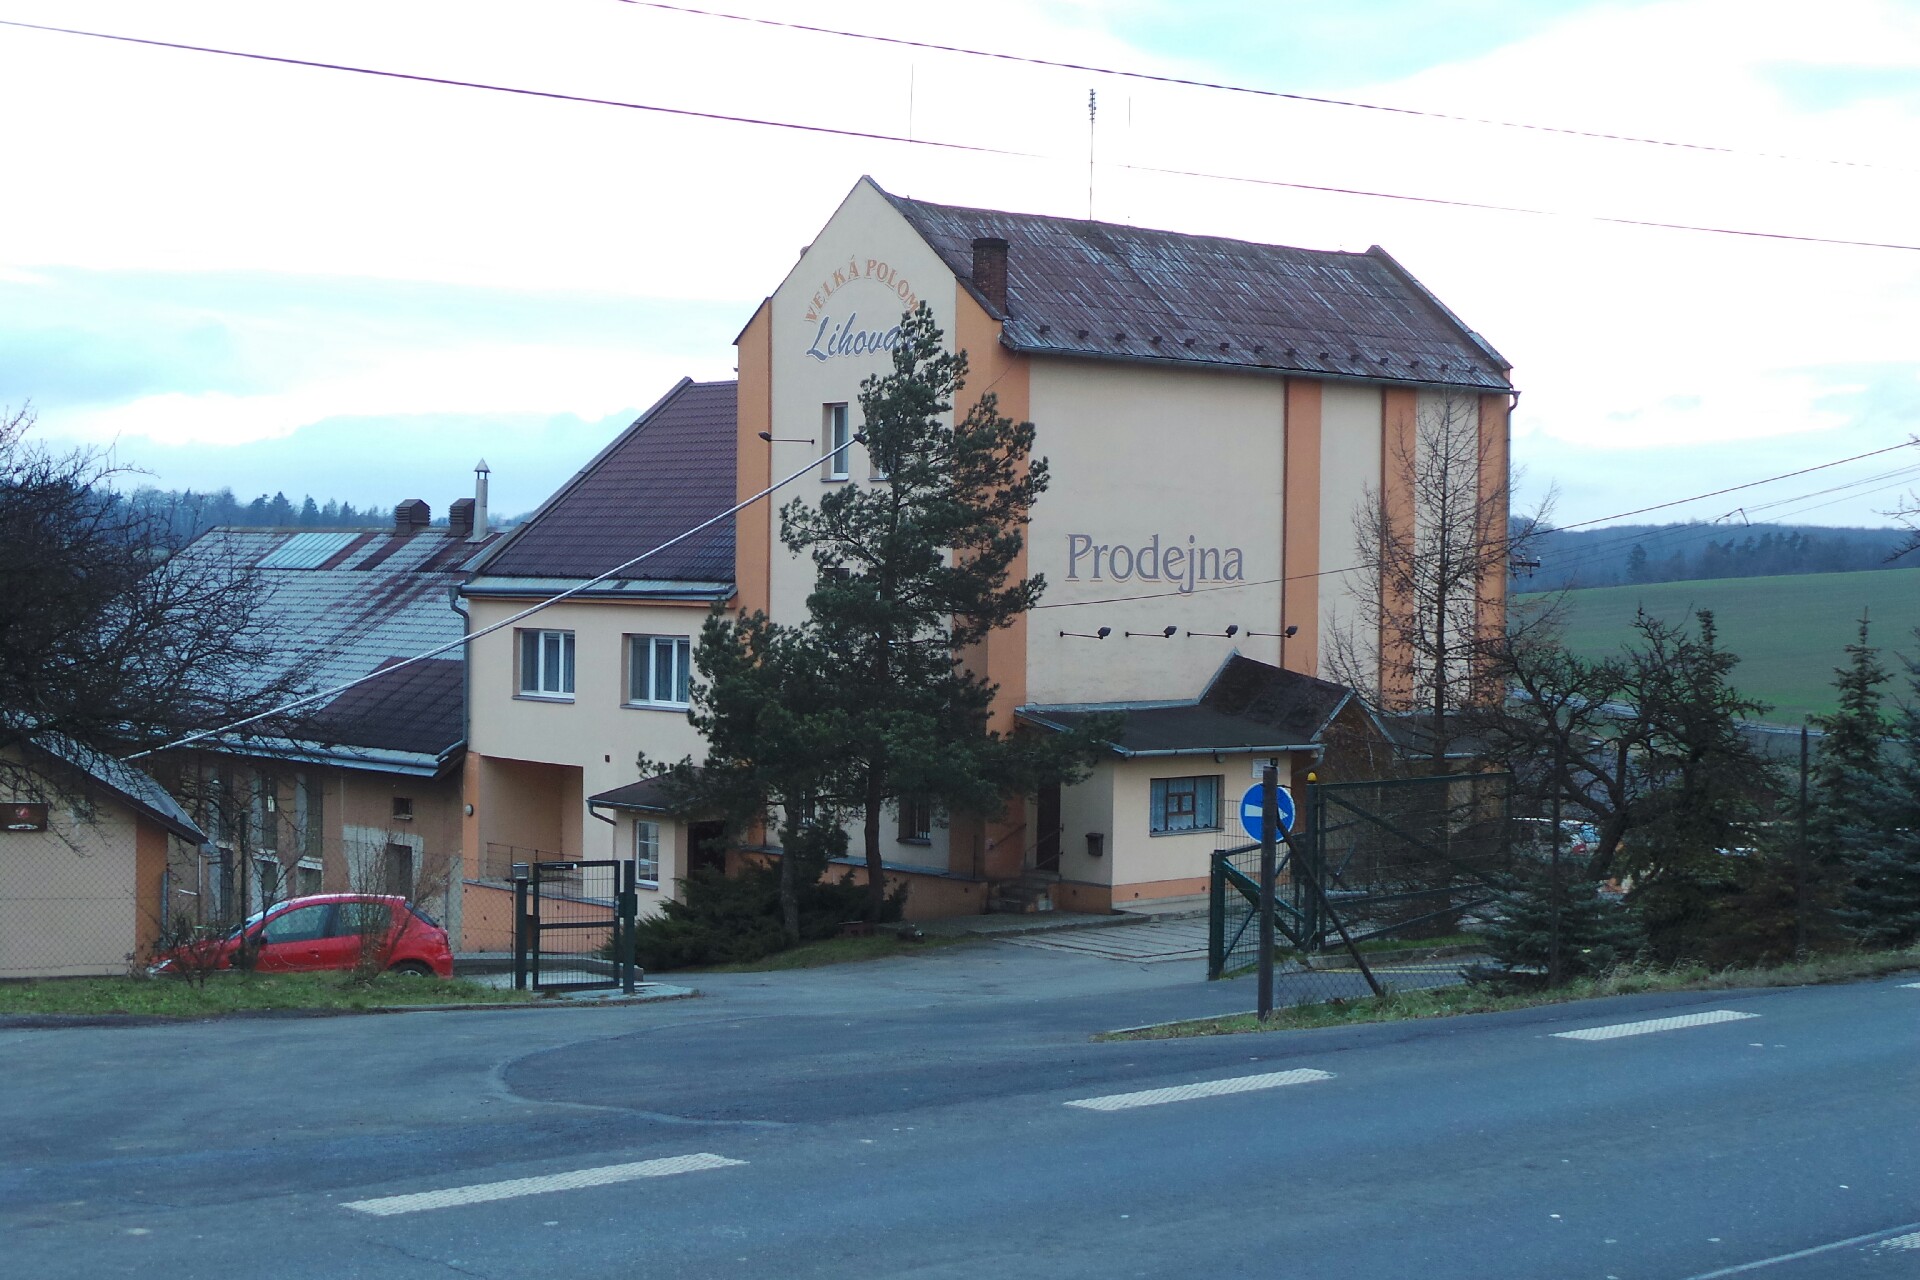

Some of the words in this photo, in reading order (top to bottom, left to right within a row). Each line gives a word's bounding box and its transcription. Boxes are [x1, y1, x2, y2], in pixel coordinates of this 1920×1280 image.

[804, 255, 860, 323] VELKÁ
[864, 259, 920, 315] POLOM
[1065, 533, 1246, 595] Prodejna
